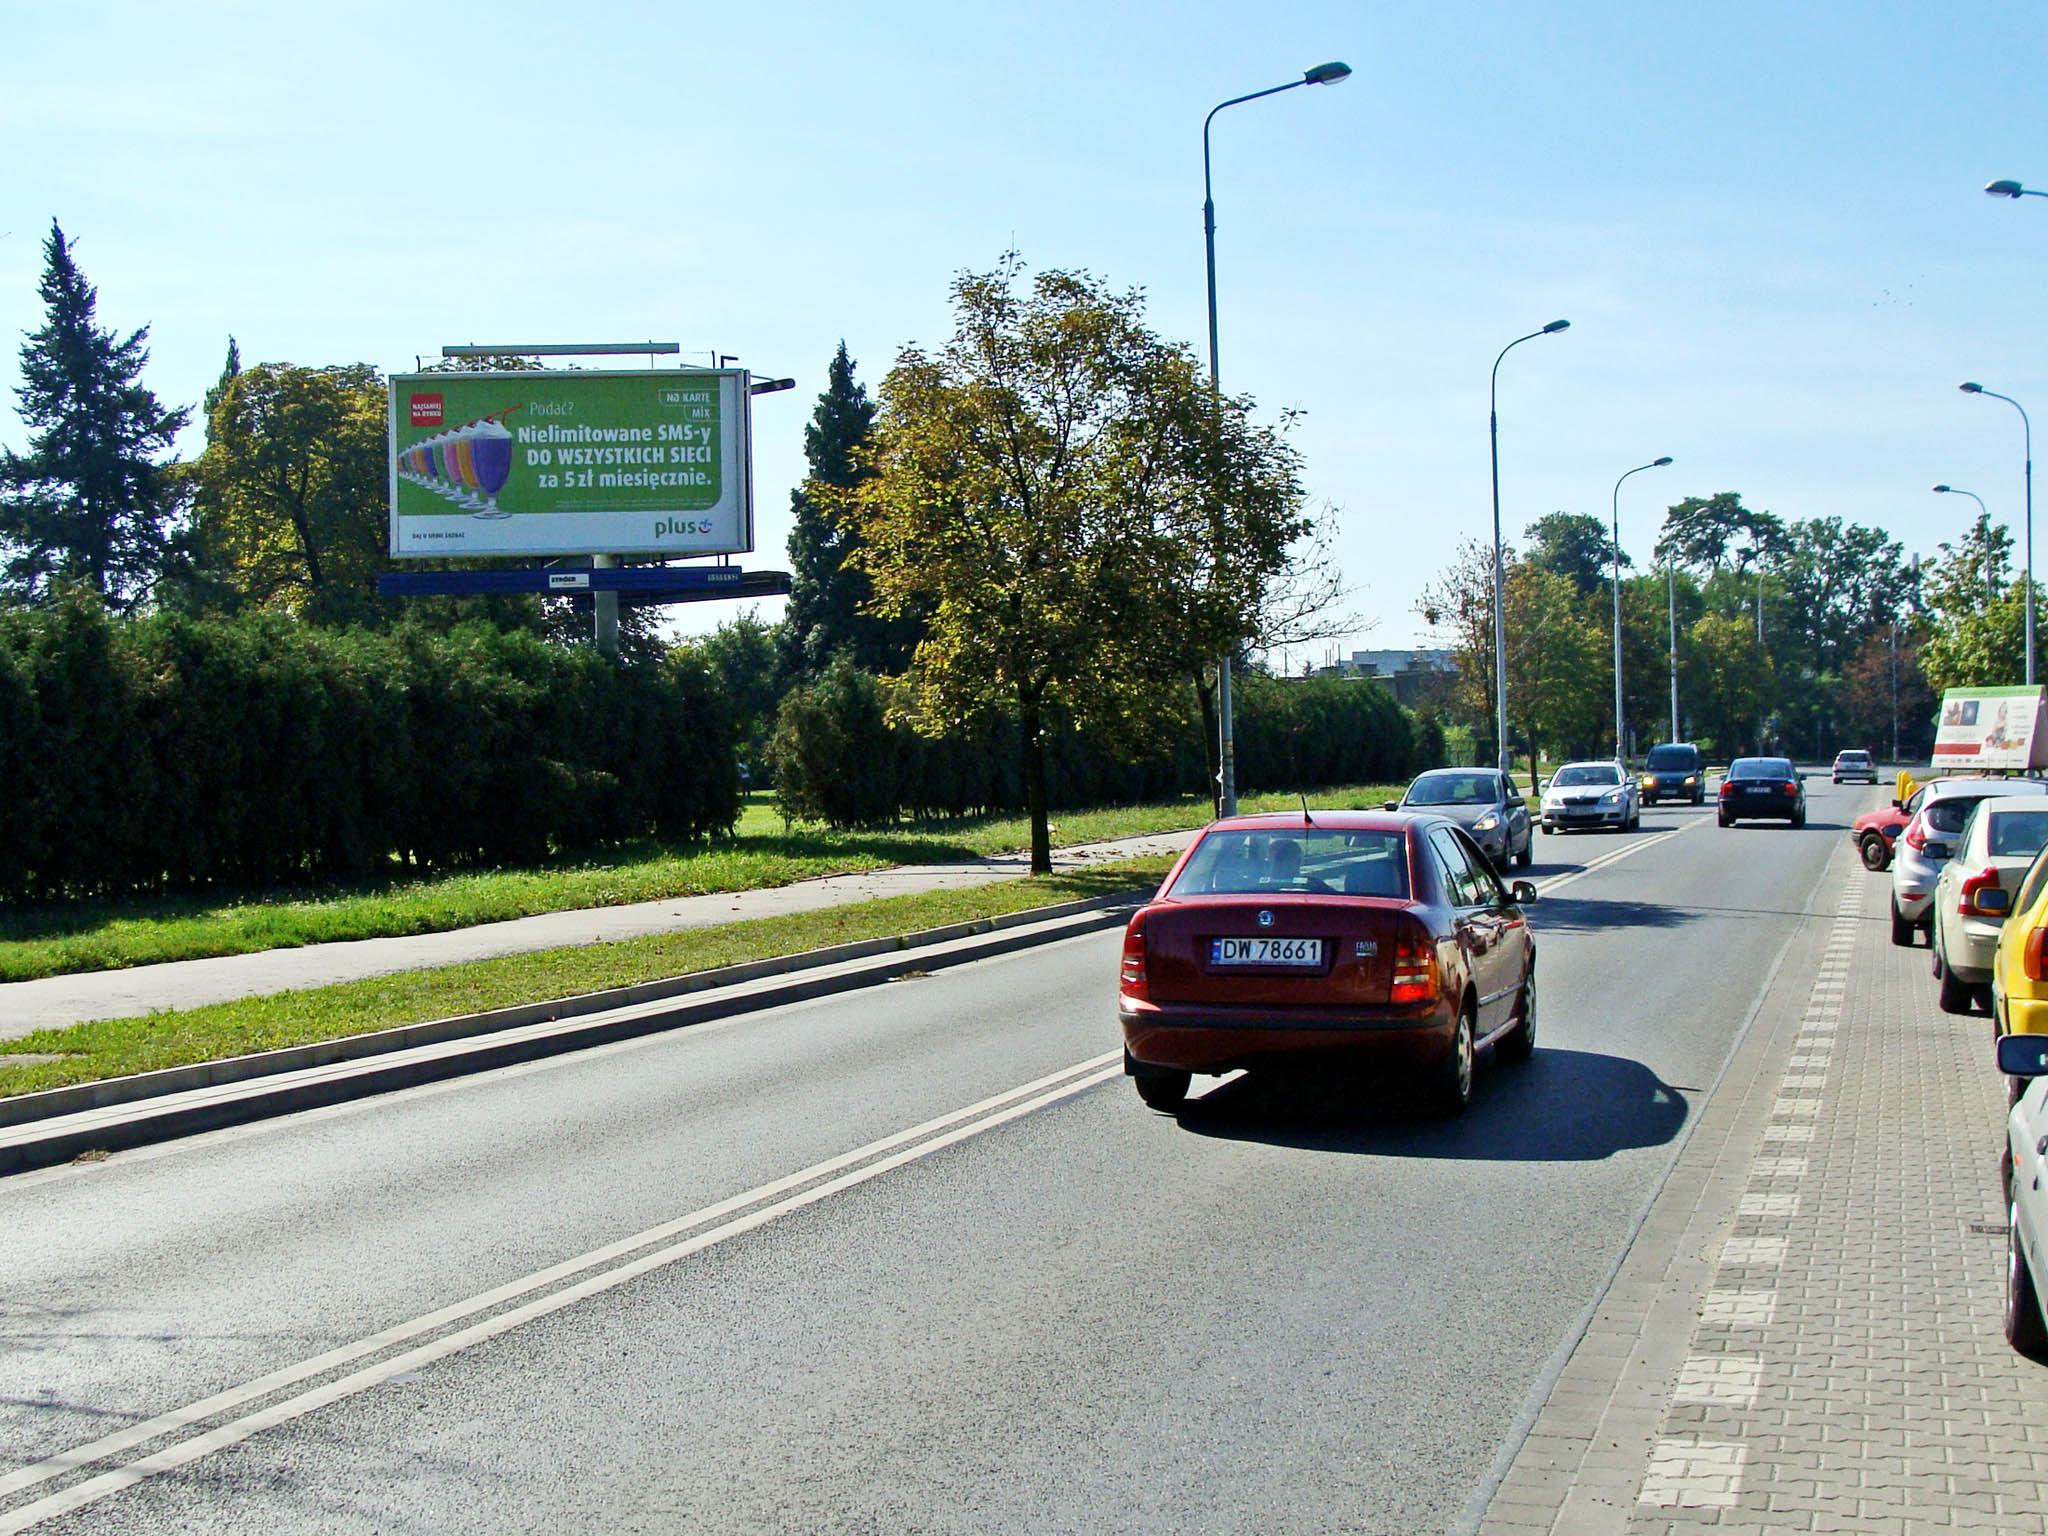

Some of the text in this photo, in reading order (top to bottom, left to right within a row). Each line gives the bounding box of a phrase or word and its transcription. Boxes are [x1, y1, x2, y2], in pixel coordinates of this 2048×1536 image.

[529, 401, 574, 416] Podać?
[518, 424, 711, 445] Nielimitowane SMS-y
[527, 446, 711, 466] DO WSZYSTKICH SIECI
[538, 466, 712, 490] za 5 zł miesięcznie.
[655, 516, 697, 539] plus
[1223, 940, 1317, 960] DW 78661
